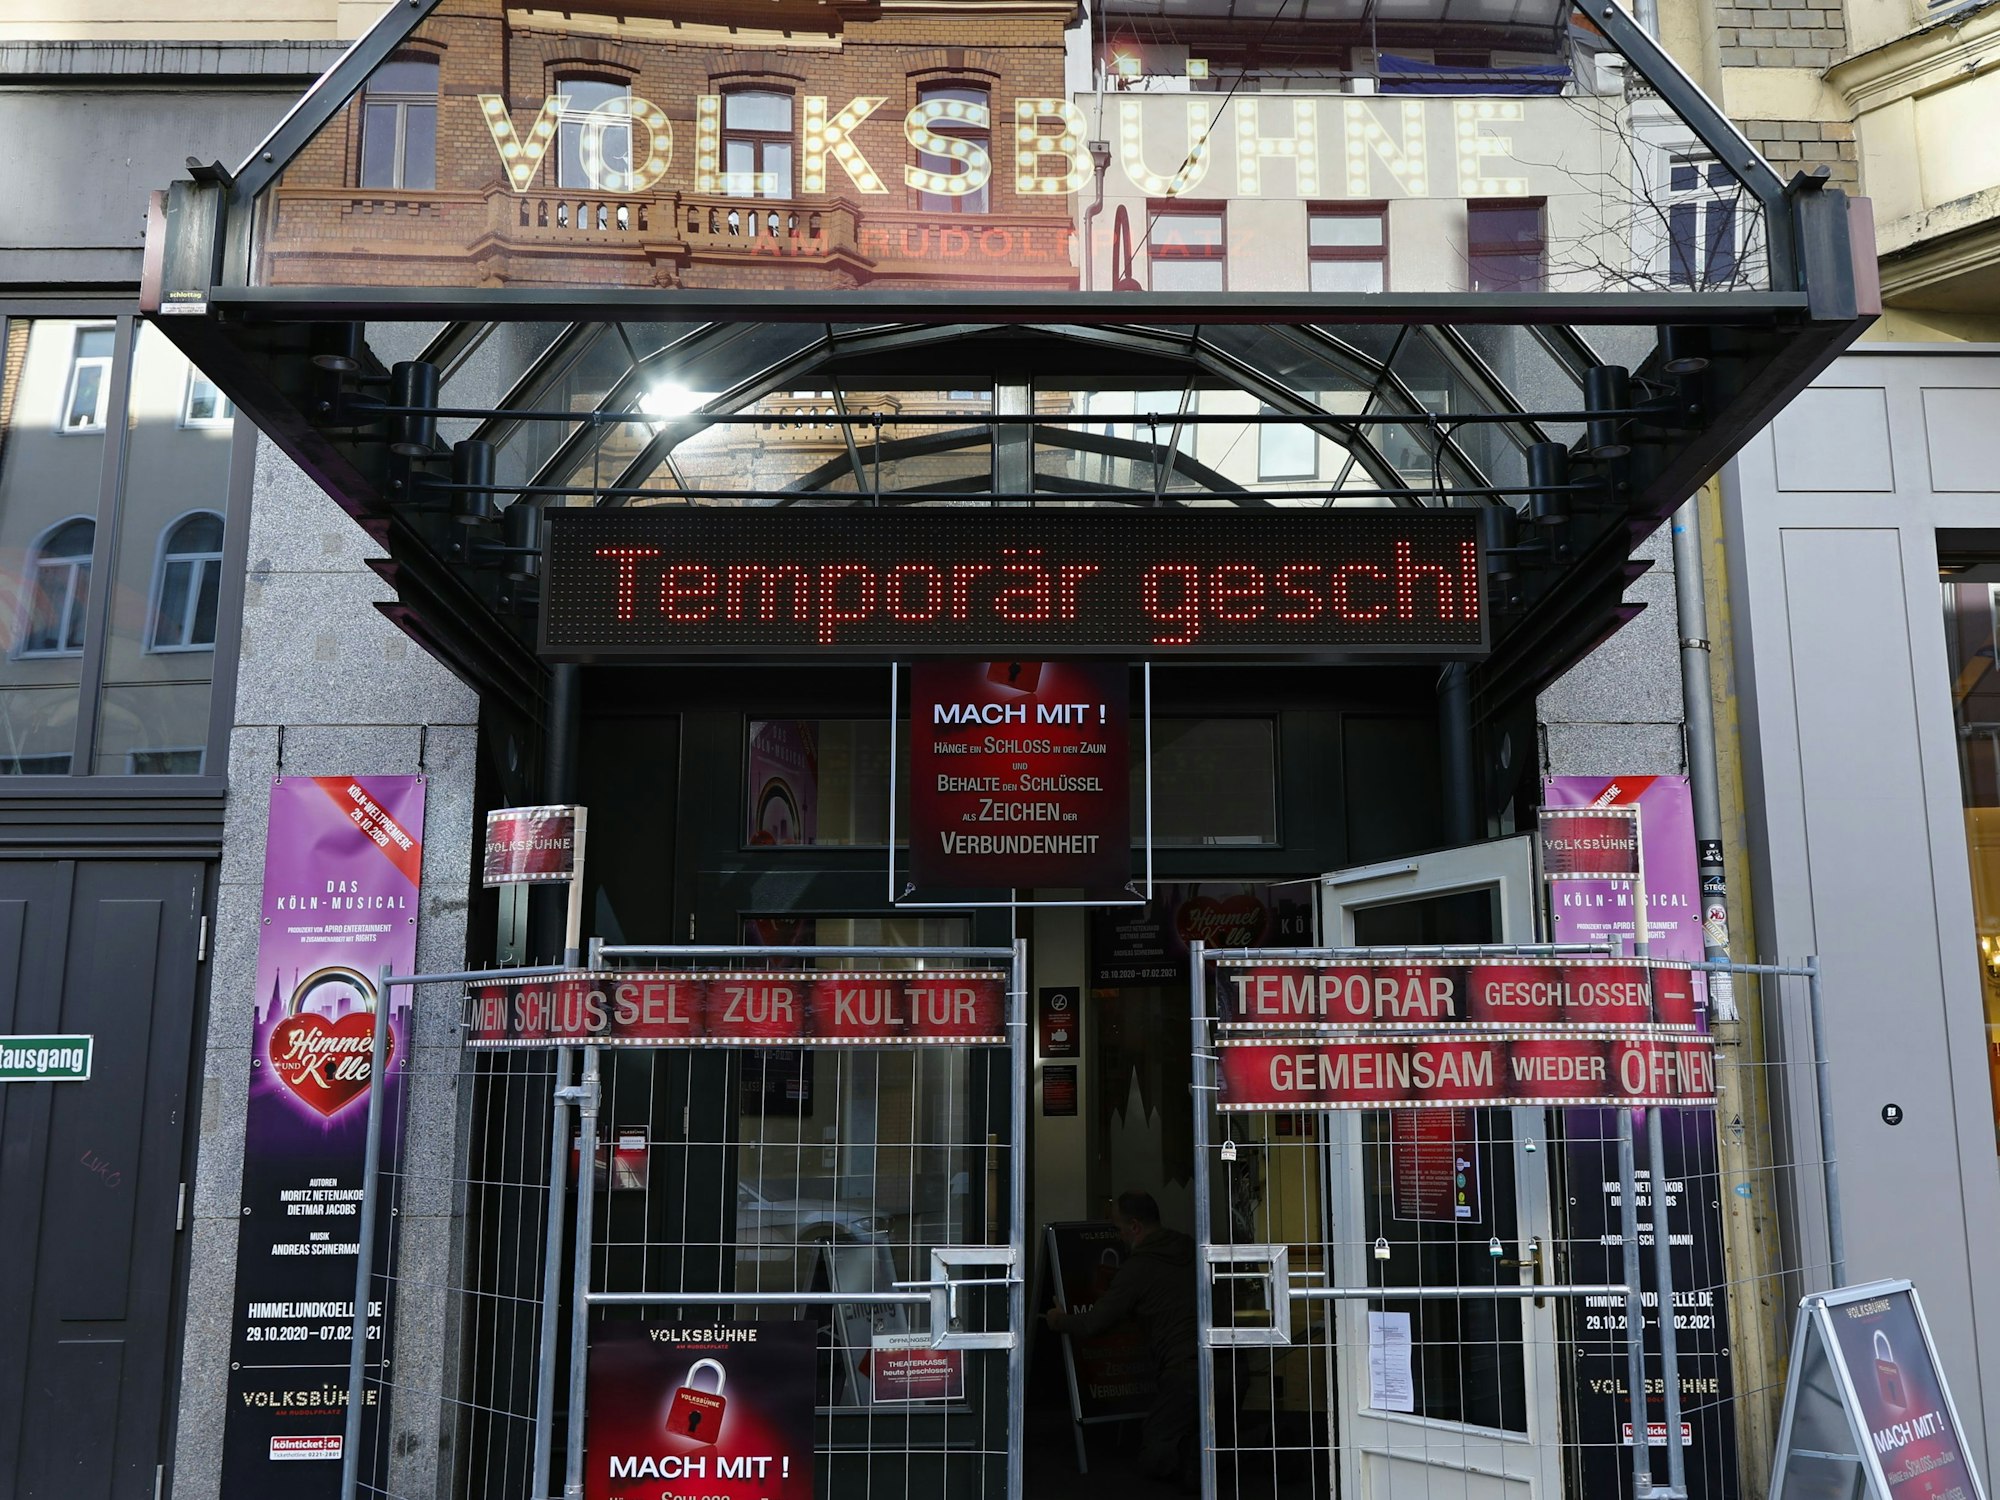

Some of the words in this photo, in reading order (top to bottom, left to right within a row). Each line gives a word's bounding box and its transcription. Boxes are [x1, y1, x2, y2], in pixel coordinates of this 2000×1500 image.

[477, 58, 1529, 198] VOLKSBÜHNE
[750, 229, 830, 257] AM
[594, 548, 1100, 645] Temporär
[1142, 540, 1479, 644] geschl
[933, 703, 1027, 724] MACH
[1036, 703, 1090, 724] MIT
[933, 740, 968, 754] HÄNGE
[984, 735, 1051, 754] SCHLOSS
[1063, 745, 1077, 754] DEN
[1080, 741, 1107, 754] ZAUN
[1012, 762, 1028, 770] UND
[937, 774, 1000, 792] BEHALTE
[1002, 783, 1018, 792] DEN
[1019, 773, 1104, 792] SCHLÜSSEL
[347, 783, 414, 852] KÖLN-WELTPREMIERE
[962, 813, 977, 822] ALS
[978, 798, 1060, 822] ZEICHEN
[1063, 813, 1078, 822] DER
[350, 807, 390, 848] 29.10.2020
[940, 831, 1100, 855] VERBUNDENHEIT
[1544, 834, 1636, 851] VOLKSBÜHNE
[327, 880, 359, 893] DAS
[277, 894, 406, 910] KÖLN-MUSICAL
[324, 924, 343, 933] APIRO
[343, 924, 392, 933] ENTERTAINMENT
[355, 933, 377, 942] RIGHTS
[1230, 968, 1456, 1018] TEMPORÄR
[1485, 981, 1650, 1007] GESCHLOSSEN
[470, 997, 508, 1032] MEIN
[514, 982, 690, 1033] SCHLÜSSEL
[722, 986, 794, 1023] ZUR
[834, 988, 977, 1026] KULTUR
[282, 1062, 301, 1070] UND
[1269, 1050, 1494, 1092] GEMEINSAM
[1511, 1055, 1607, 1082] WIEDER
[1620, 1040, 1715, 1095] ÖFFNEN
[309, 1178, 338, 1187] AUTOREN
[280, 1189, 312, 1202] MORITZ
[287, 1204, 324, 1216] DIETMAR
[325, 1203, 356, 1216] JACOBS
[310, 1232, 330, 1241] MUSIK
[271, 1243, 310, 1256] ANDREAS
[246, 1326, 308, 1341] 29.10.2020
[650, 1323, 758, 1342] VOLKSBÜHNE
[883, 1369, 905, 1377] heute
[906, 1367, 953, 1376] geschlossen
[888, 1358, 948, 1368] THEATERKASSE
[680, 1393, 720, 1408] VOLKSBÜHNE
[1873, 1421, 1914, 1454] MACH
[1912, 1412, 1937, 1440] MIT
[609, 1455, 706, 1479] MACH
[716, 1455, 773, 1479] MIT
